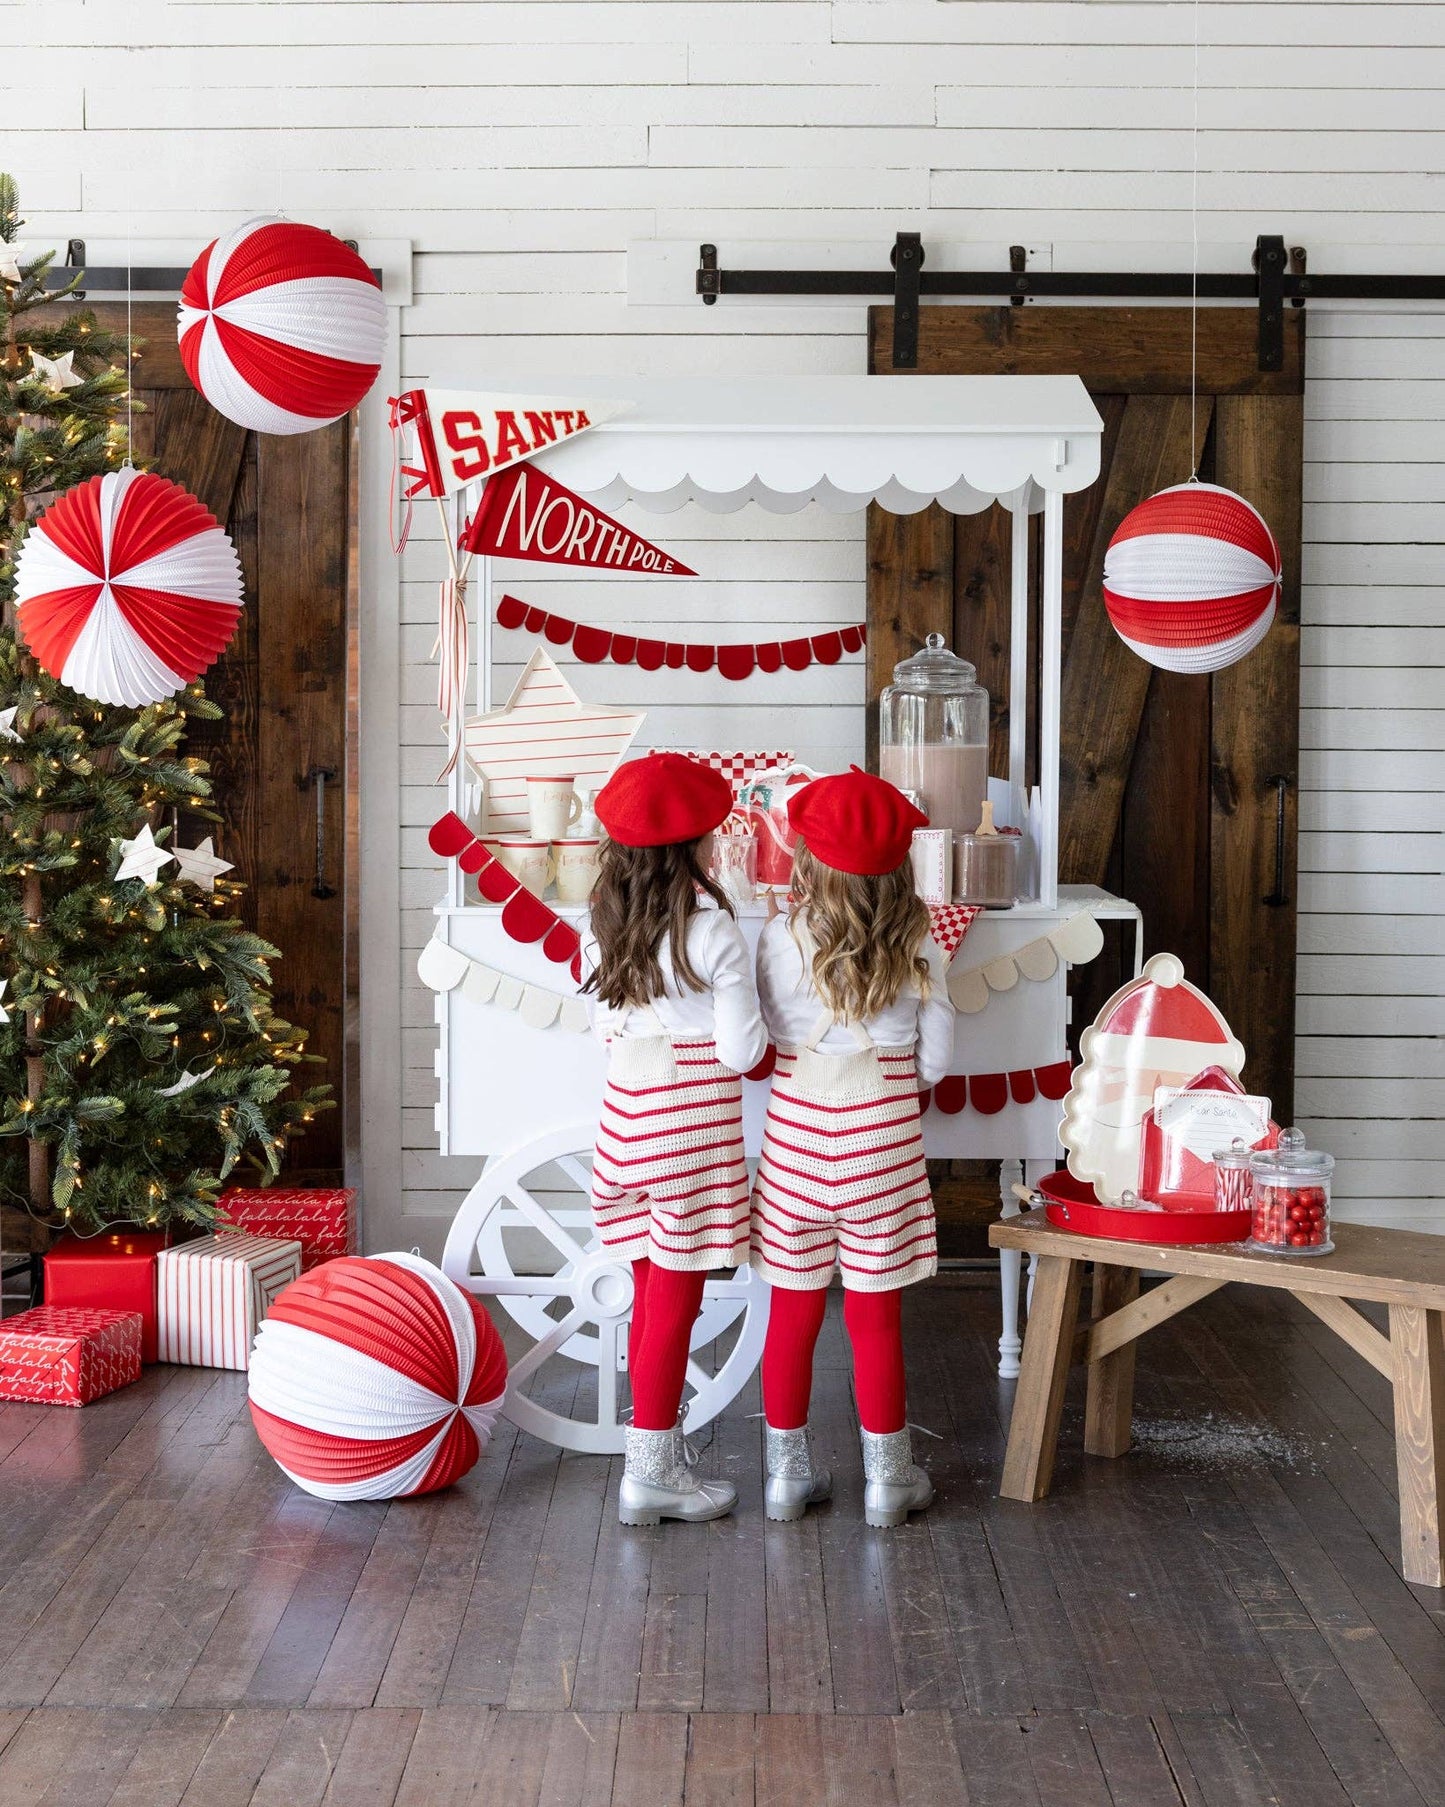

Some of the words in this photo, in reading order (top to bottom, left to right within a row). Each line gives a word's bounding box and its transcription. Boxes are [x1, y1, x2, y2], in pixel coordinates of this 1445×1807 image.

[441, 410, 591, 481] SANTA
[496, 471, 631, 567] NORTH
[628, 541, 675, 573] POLE
[1190, 1104, 1210, 1116] ar
